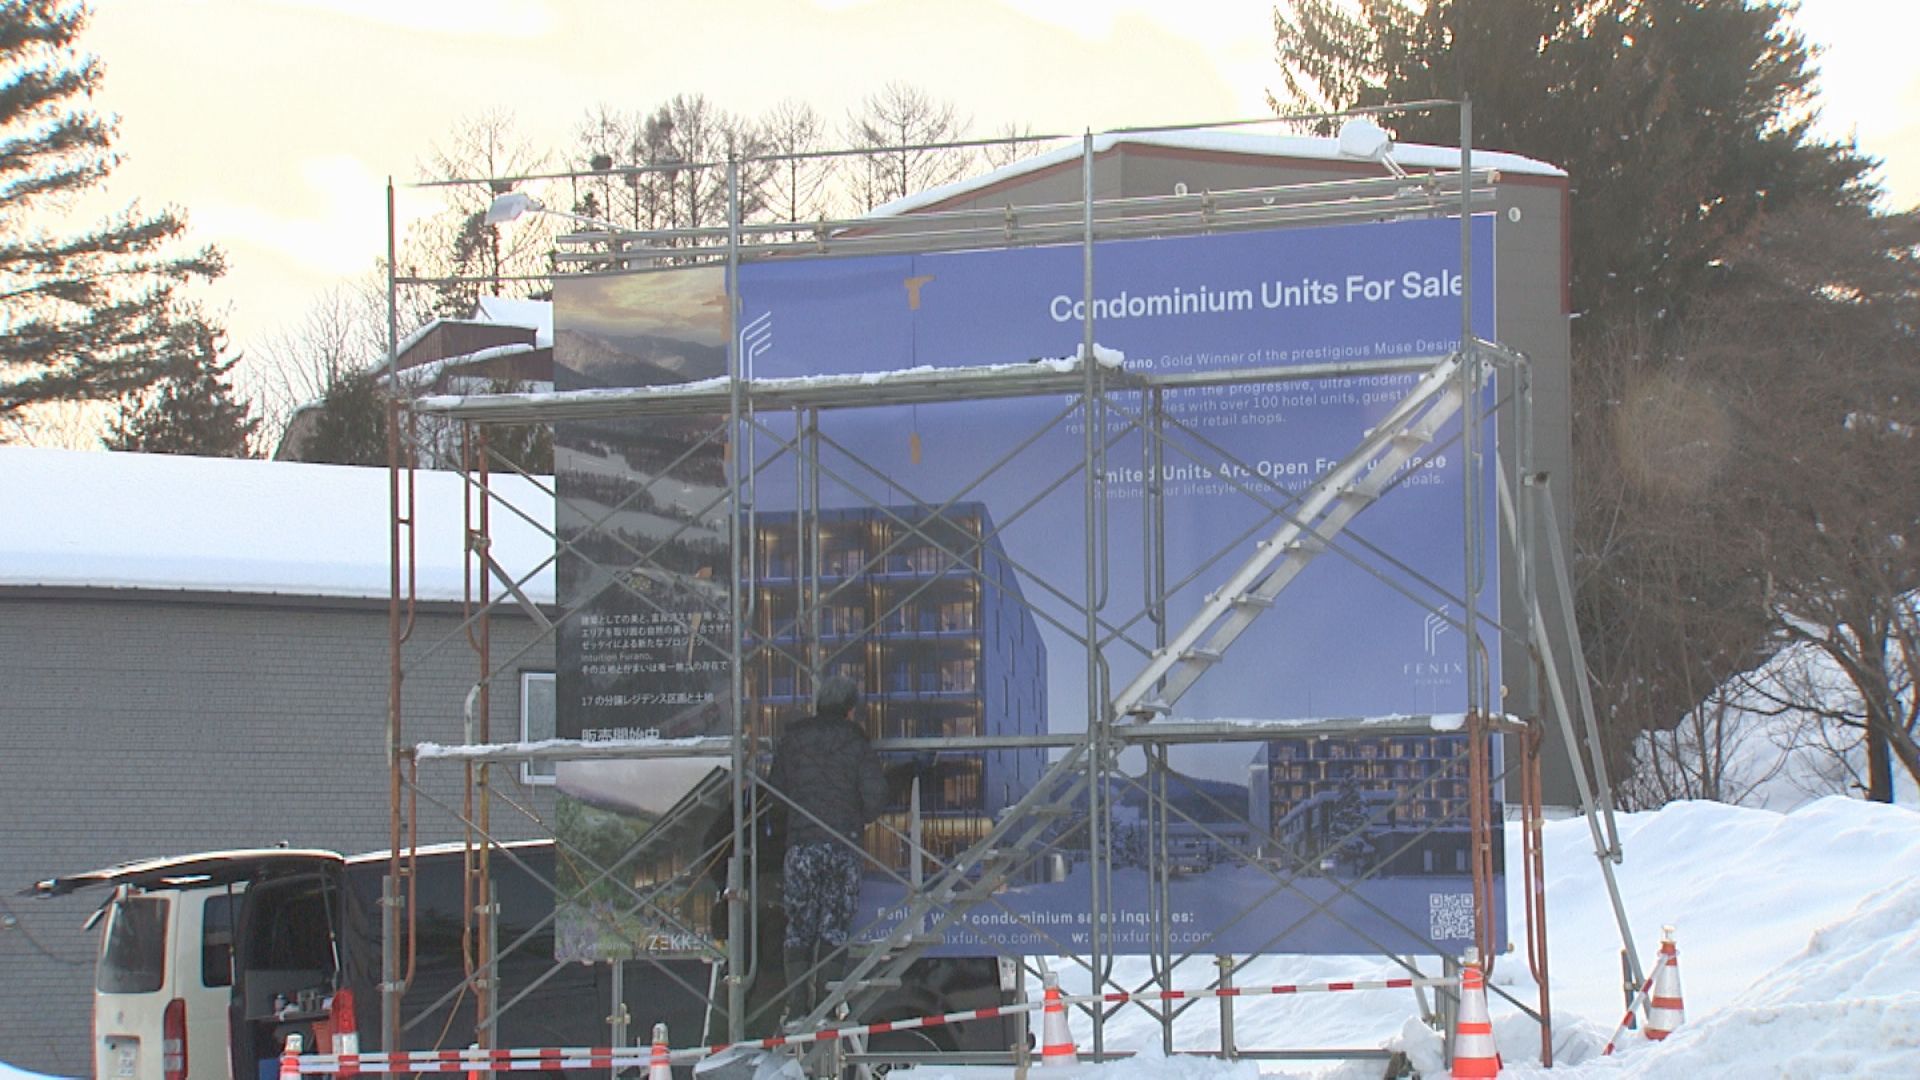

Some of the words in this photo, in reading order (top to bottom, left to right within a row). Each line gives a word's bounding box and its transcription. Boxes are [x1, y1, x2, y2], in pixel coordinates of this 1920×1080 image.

[1050, 285, 1253, 322] Condominium
[1261, 277, 1339, 309] Units
[1346, 275, 1395, 302] For
[1402, 268, 1463, 299] Sale
[1123, 358, 1157, 371] rano,
[1160, 355, 1193, 368] Gold
[1196, 352, 1244, 366] Winner
[1247, 349, 1262, 362] of
[1266, 348, 1288, 360] the
[1291, 345, 1371, 362] prestigious
[1374, 342, 1413, 355] Muse
[1202, 384, 1224, 396] the
[1230, 379, 1314, 397] progressive,
[1319, 373, 1412, 389] ultra-modern
[1188, 398, 1217, 411] with
[1220, 400, 1249, 411] over
[1253, 397, 1279, 409] 100
[1282, 393, 1318, 406] hotel
[1320, 390, 1360, 406] units,
[1203, 413, 1238, 427] retail
[1242, 411, 1287, 425] shops.
[1162, 463, 1213, 481] Units
[1257, 460, 1308, 479] Open
[1077, 911, 1117, 925] saes
